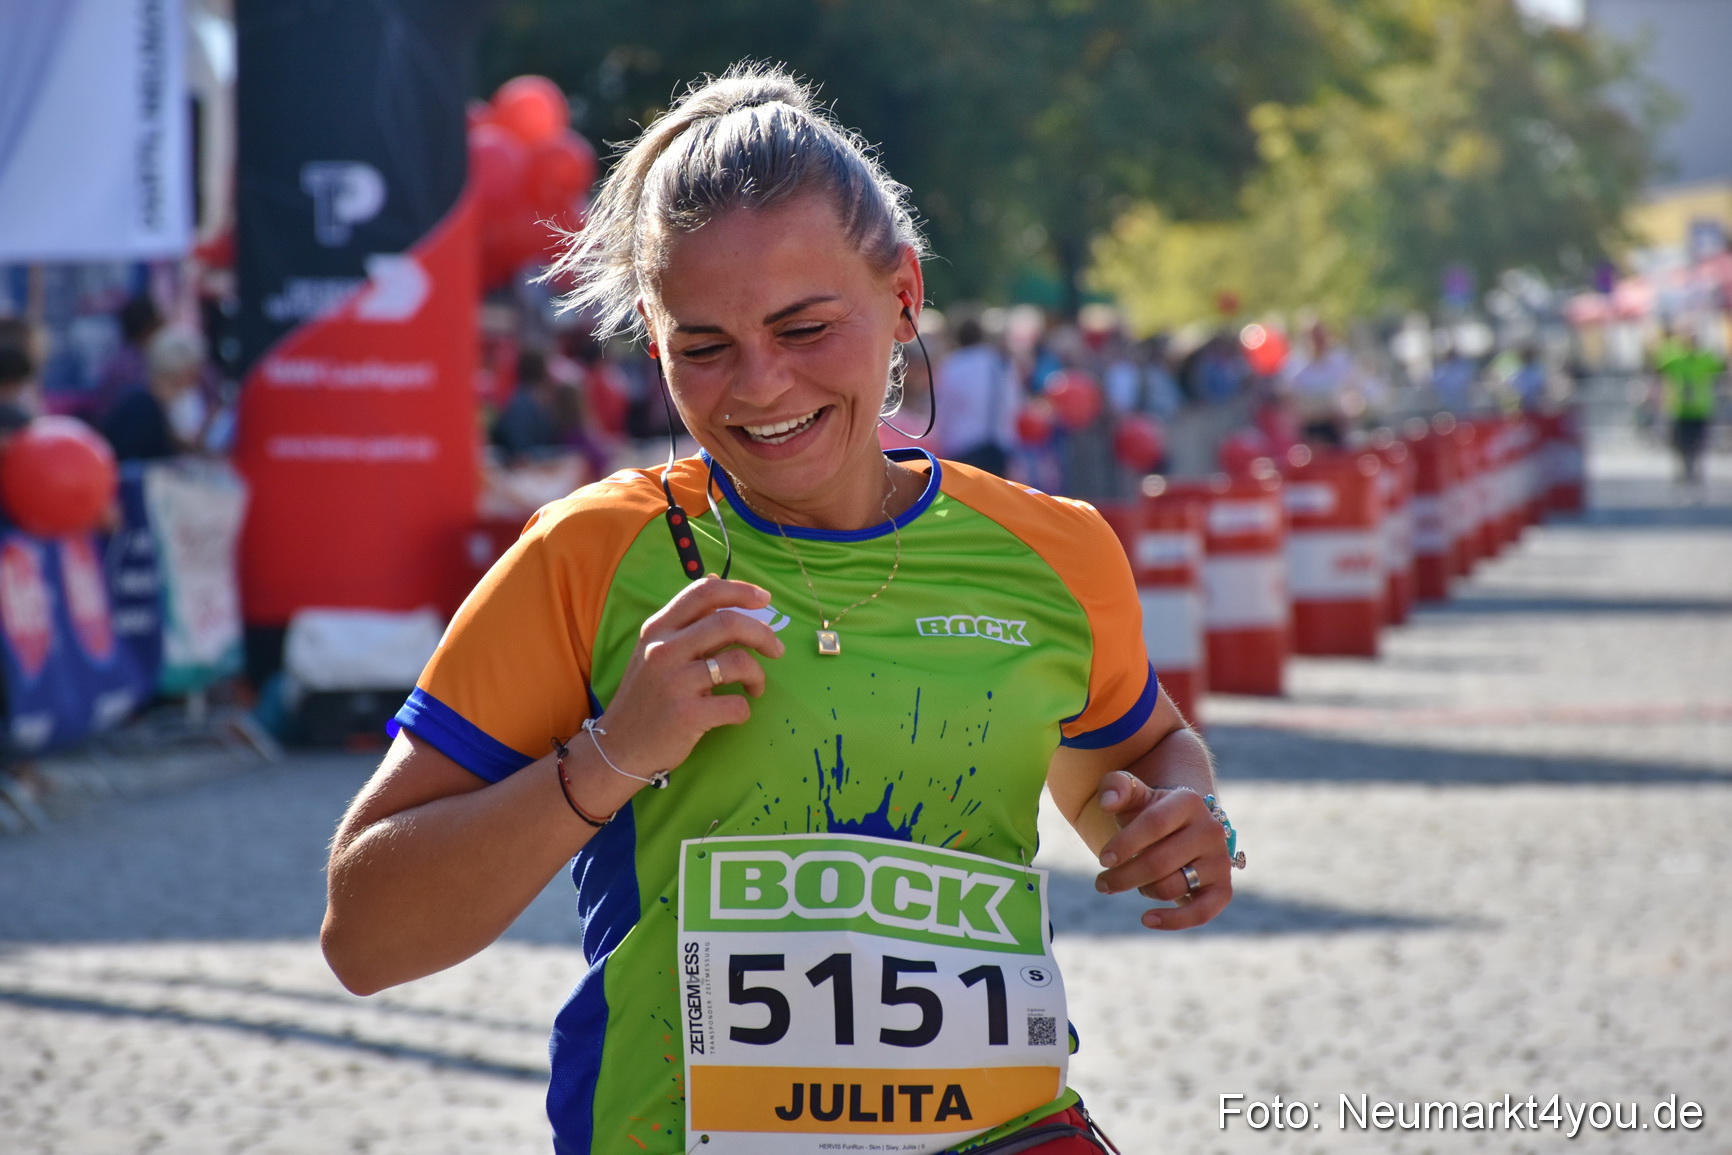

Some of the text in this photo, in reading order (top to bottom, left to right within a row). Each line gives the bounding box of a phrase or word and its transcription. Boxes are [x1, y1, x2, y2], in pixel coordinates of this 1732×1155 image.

[916, 614, 1031, 647] BOCK
[710, 851, 1020, 945] BOCK
[1028, 969, 1044, 981] S
[728, 953, 1009, 1048] 5151
[707, 1000, 715, 1054] TRANSPONDER
[774, 1083, 973, 1123] JULITA
[842, 1143, 864, 1151] FunRun
